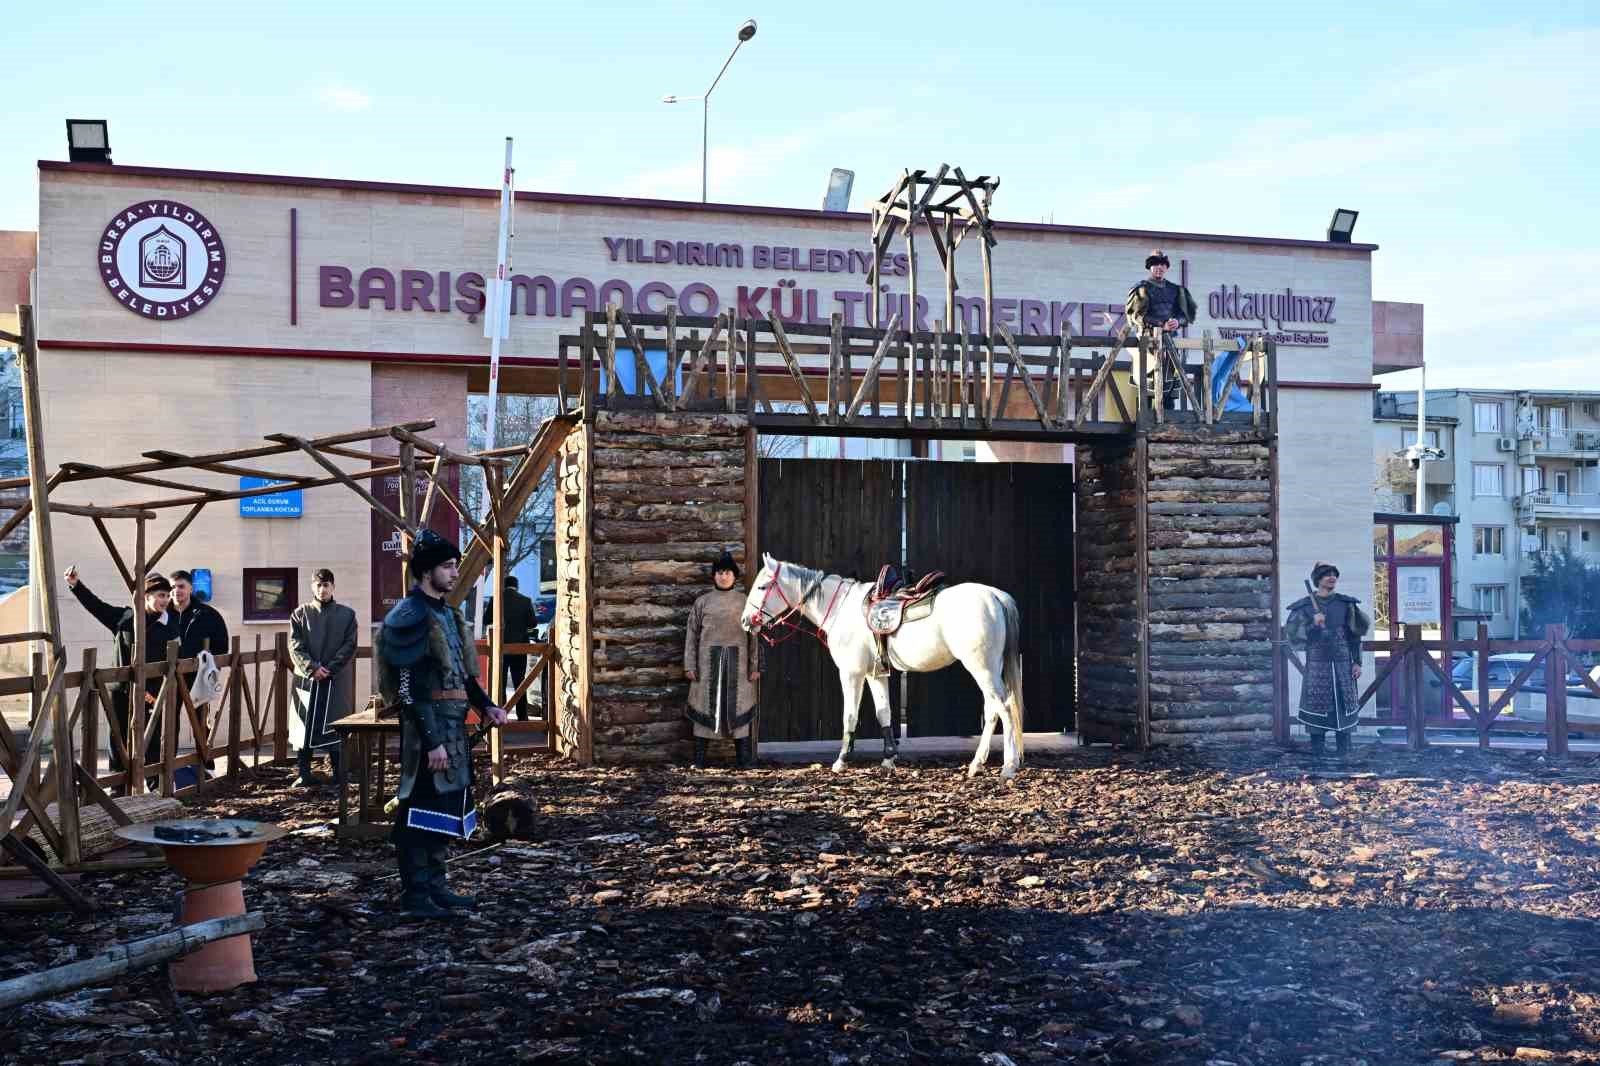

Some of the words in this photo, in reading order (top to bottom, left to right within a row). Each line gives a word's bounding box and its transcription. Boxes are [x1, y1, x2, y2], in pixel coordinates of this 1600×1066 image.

[102, 211, 138, 264] BURSA
[148, 204, 221, 262] YILDIRIM
[603, 237, 743, 268] YILDIRIM
[753, 245, 917, 276] BELEDİYES
[320, 265, 486, 323] BARIŞ
[737, 278, 929, 331] KÜLTÜR
[945, 296, 1127, 336] MERKEZ
